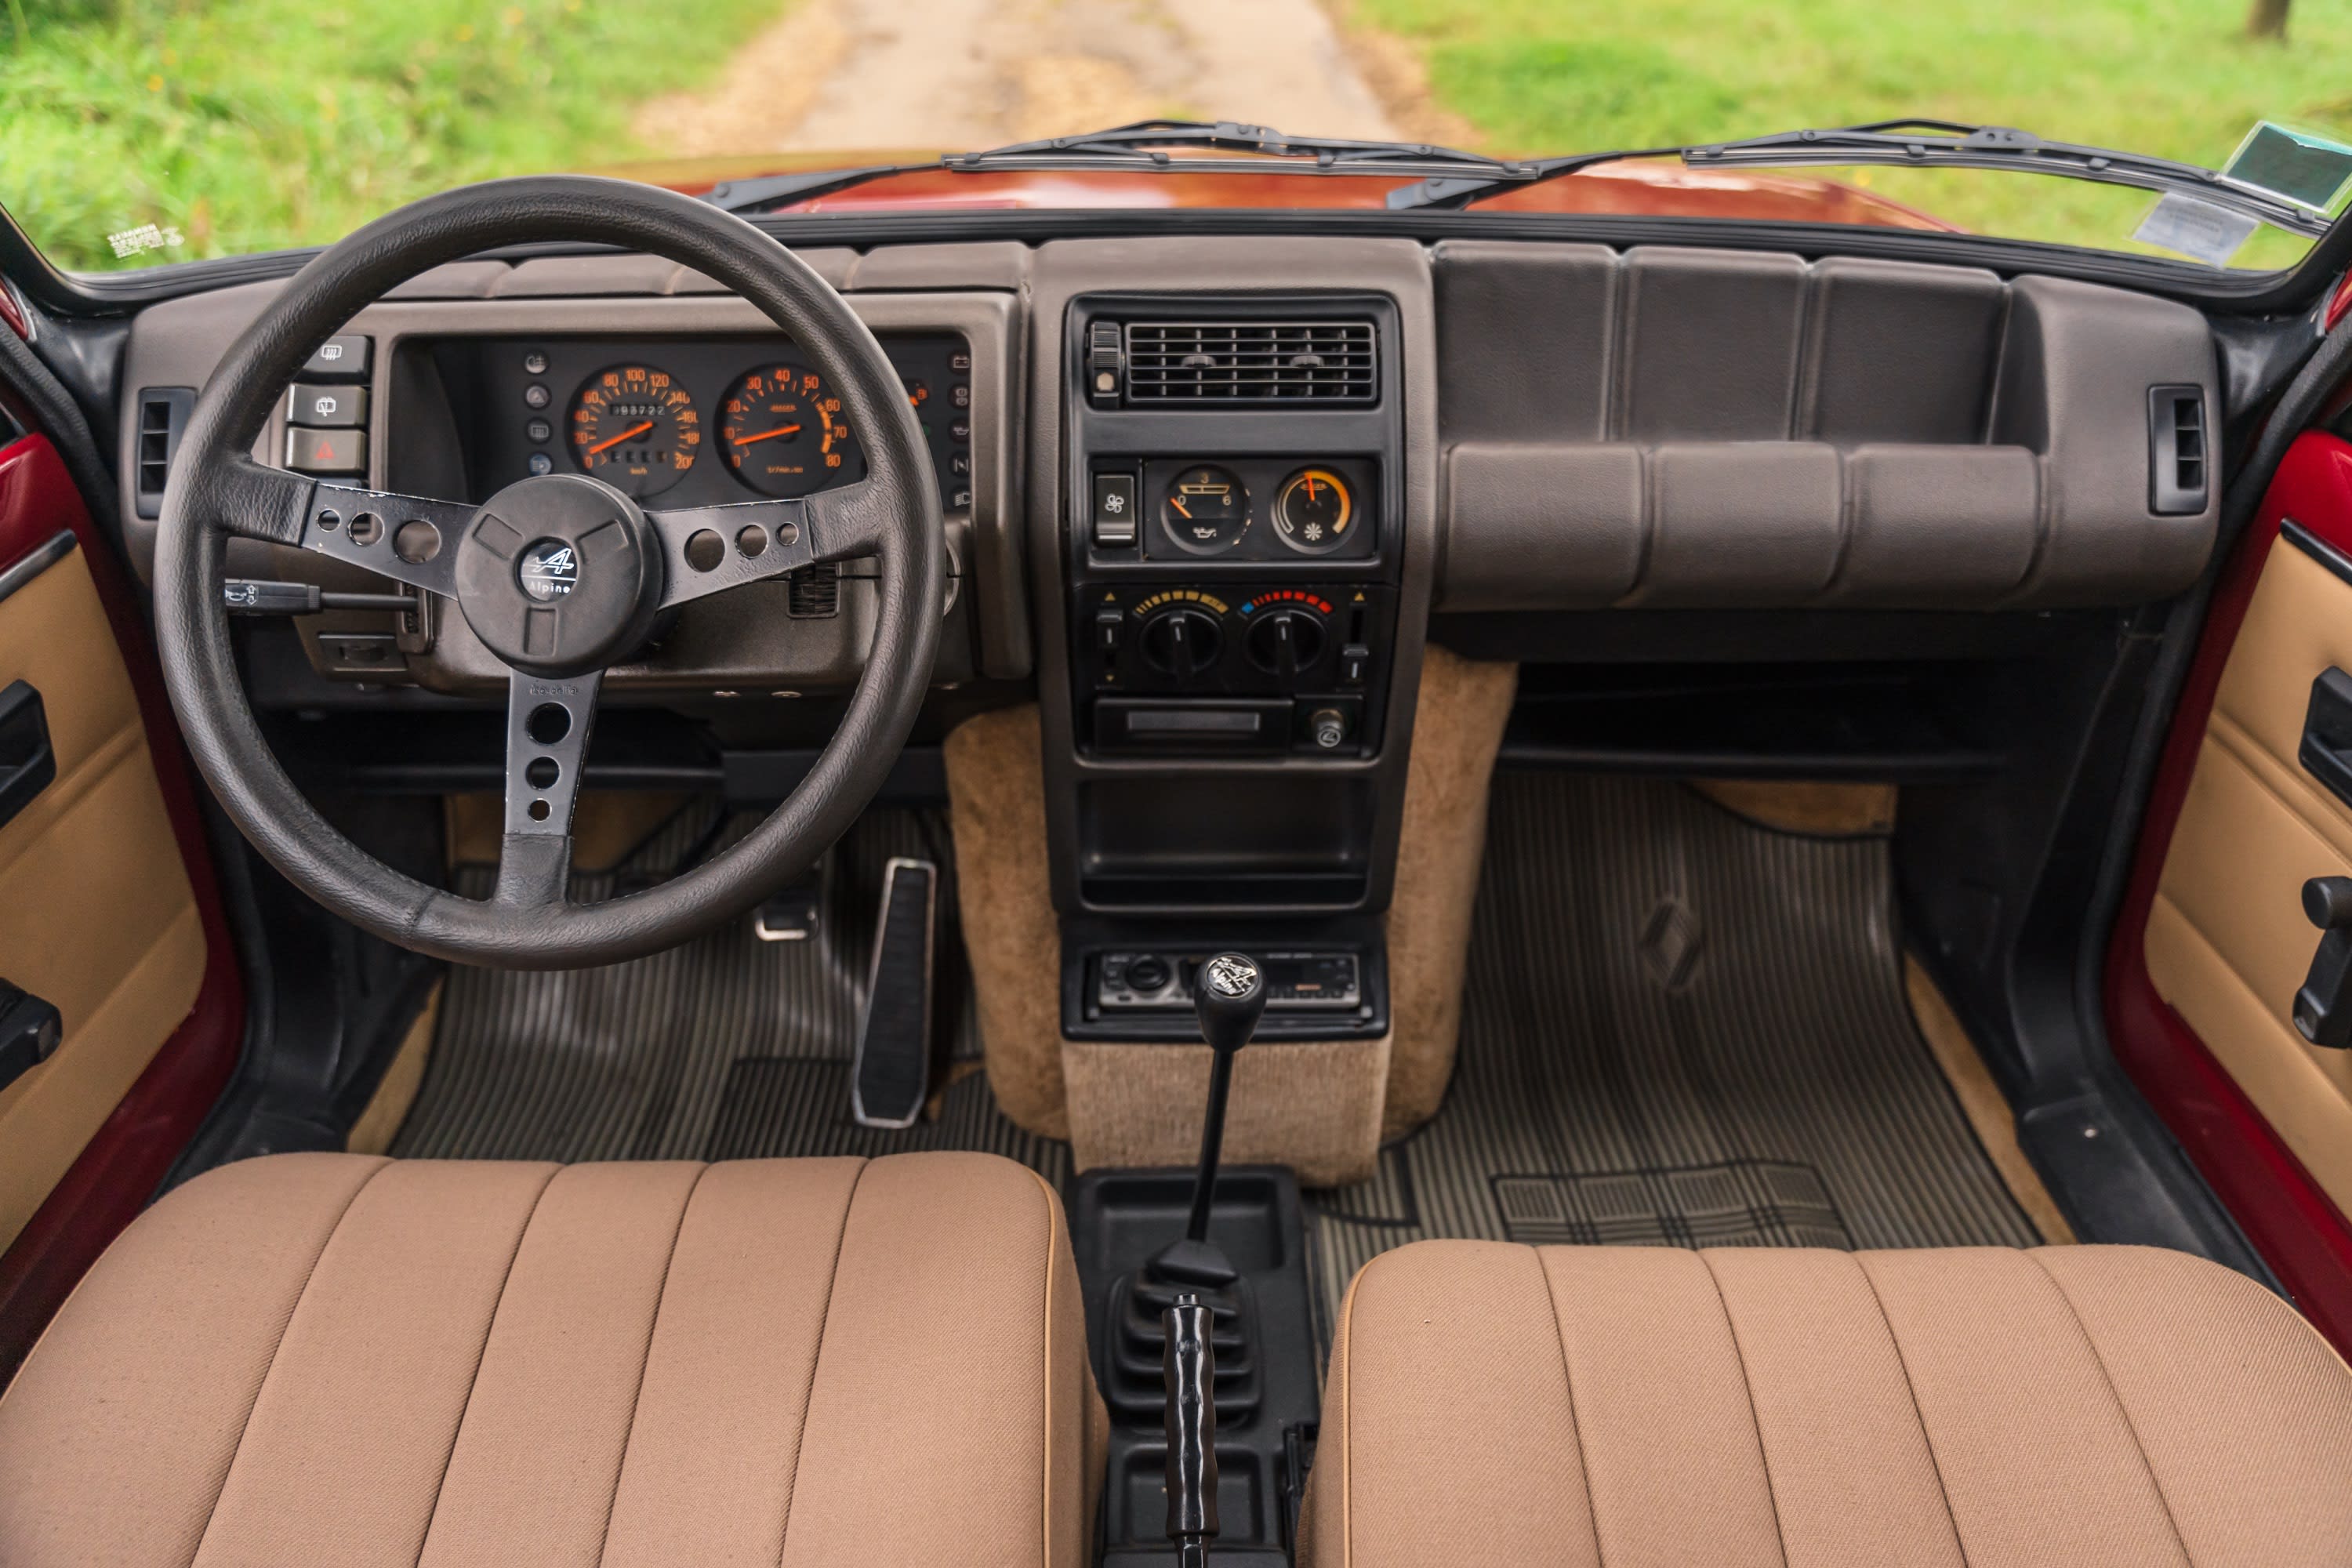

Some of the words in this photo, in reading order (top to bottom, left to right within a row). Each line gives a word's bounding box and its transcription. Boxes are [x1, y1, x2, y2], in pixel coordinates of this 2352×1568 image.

[603, 373, 619, 387] 80
[626, 370, 645, 382] 100
[650, 375, 670, 387] 120
[775, 370, 790, 382] 40
[746, 376, 762, 390] 30
[804, 376, 819, 389] 50
[583, 391, 600, 404] 60
[728, 401, 741, 412] 20
[826, 400, 840, 412] 60
[724, 427, 735, 439] 10
[834, 426, 848, 438] 70
[575, 432, 589, 445] 20
[583, 456, 593, 470] 0
[732, 455, 741, 468] 0
[826, 454, 841, 467] 80
[1200, 474, 1209, 484] 3
[1178, 495, 1187, 506] 0
[1222, 495, 1232, 506] 6
[530, 581, 572, 594] Alpine
